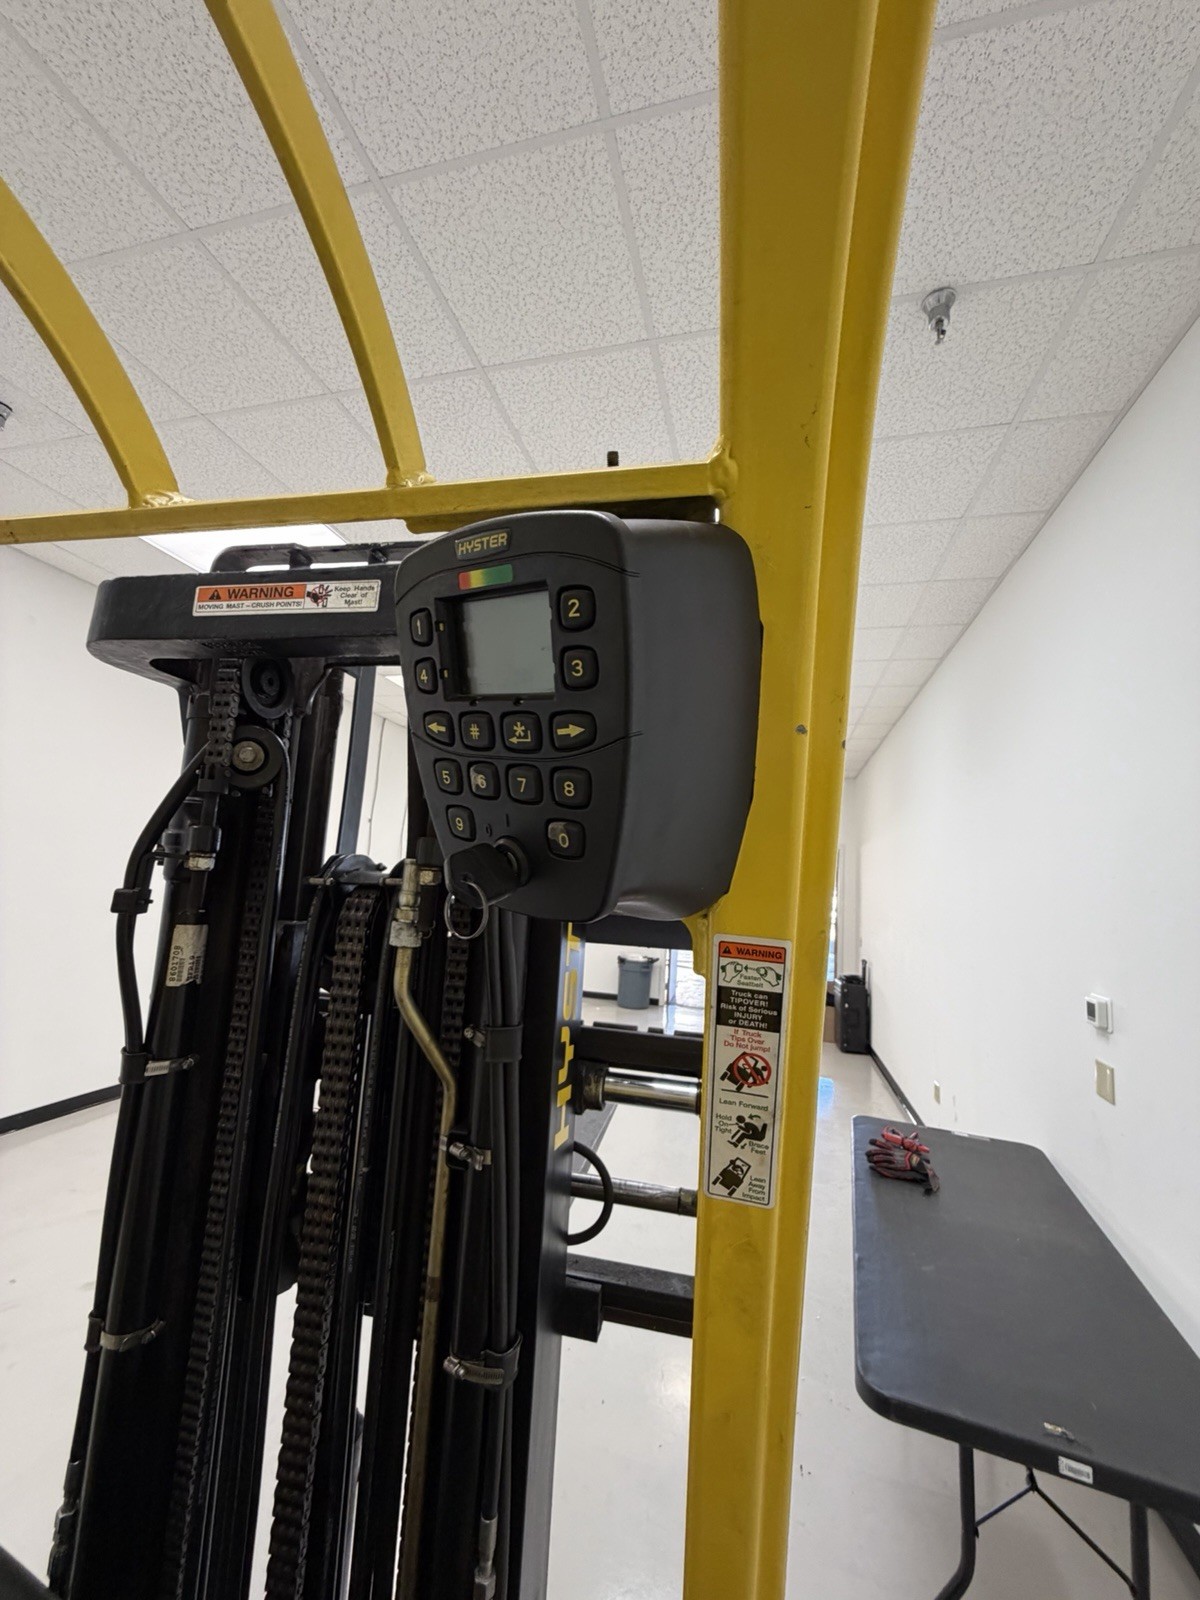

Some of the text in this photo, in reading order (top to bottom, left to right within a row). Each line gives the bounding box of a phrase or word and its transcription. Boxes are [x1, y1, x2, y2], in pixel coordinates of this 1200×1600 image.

[458, 532, 508, 555] HYSTER
[227, 586, 294, 600] WARNING
[334, 585, 350, 593] Keep
[568, 599, 581, 617] 2
[416, 619, 421, 635] 1
[571, 660, 583, 677] 3
[420, 669, 428, 683] 4
[442, 770, 451, 784] 5
[477, 773, 487, 788] 6
[517, 778, 526, 792] 7
[564, 781, 575, 797] 8
[455, 817, 464, 831] 9
[559, 833, 569, 848] 0
[736, 947, 782, 960] WARNING
[740, 973, 761, 981] Fasten
[731, 989, 752, 998] Truck
[730, 996, 769, 1007] TIPOVER!
[720, 1003, 737, 1011] Risk
[748, 1006, 778, 1016] Serious
[734, 1012, 763, 1021] INJURY
[738, 1019, 768, 1029] DEATH!
[742, 1029, 762, 1038] Truck
[730, 1035, 765, 1045] Tips Over
[736, 1042, 749, 1050] Not
[718, 1098, 769, 1111] Lean Forward
[714, 1126, 732, 1135] Tight
[748, 1141, 770, 1150] Brace
[749, 1175, 767, 1183] Lean
[748, 1182, 766, 1190] Away
[748, 1187, 766, 1195] From
[742, 1192, 766, 1202] Impact
